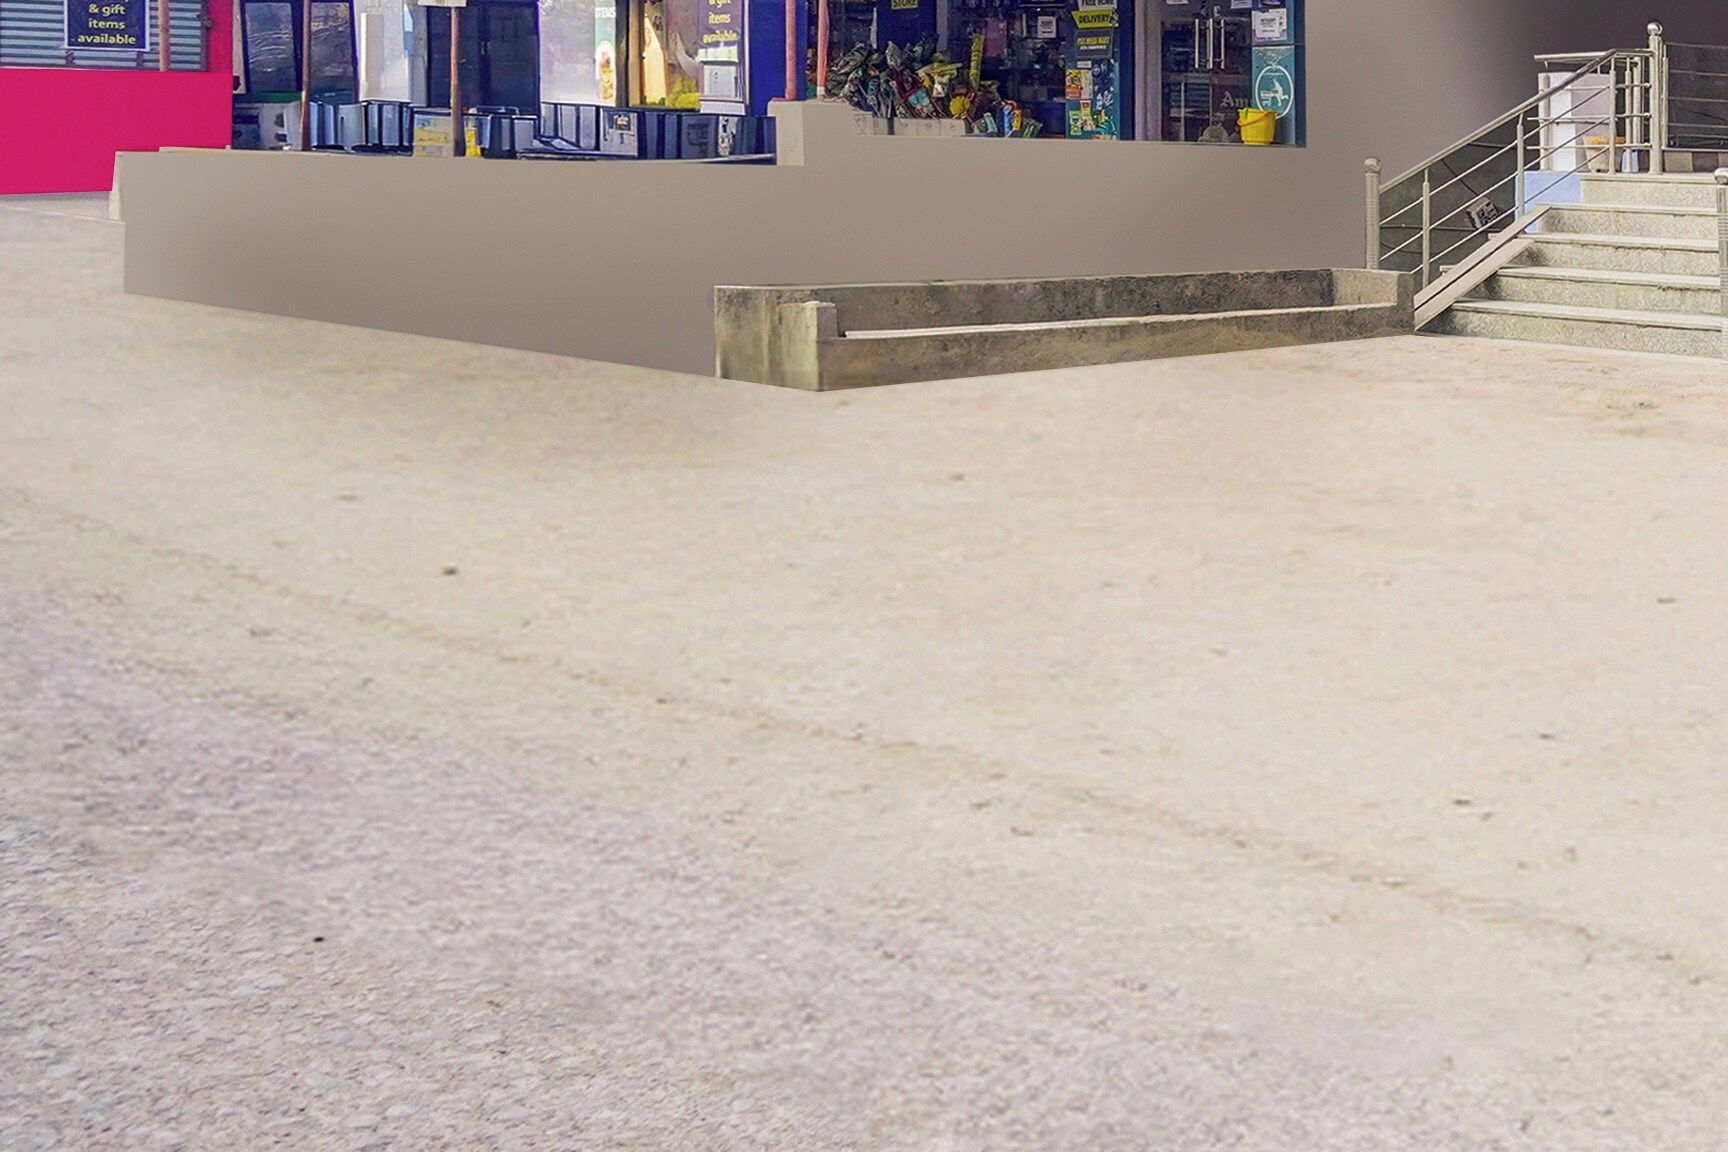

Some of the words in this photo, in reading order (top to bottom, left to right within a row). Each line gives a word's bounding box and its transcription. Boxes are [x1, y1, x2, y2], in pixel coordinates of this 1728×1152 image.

[1082, 0, 1097, 7] FREE
[88, 3, 99, 14] &
[102, 4, 126, 17] gift
[709, 12, 731, 24] items
[1079, 14, 1110, 24] DELIVERY
[88, 18, 126, 29] items
[77, 34, 136, 44] available
